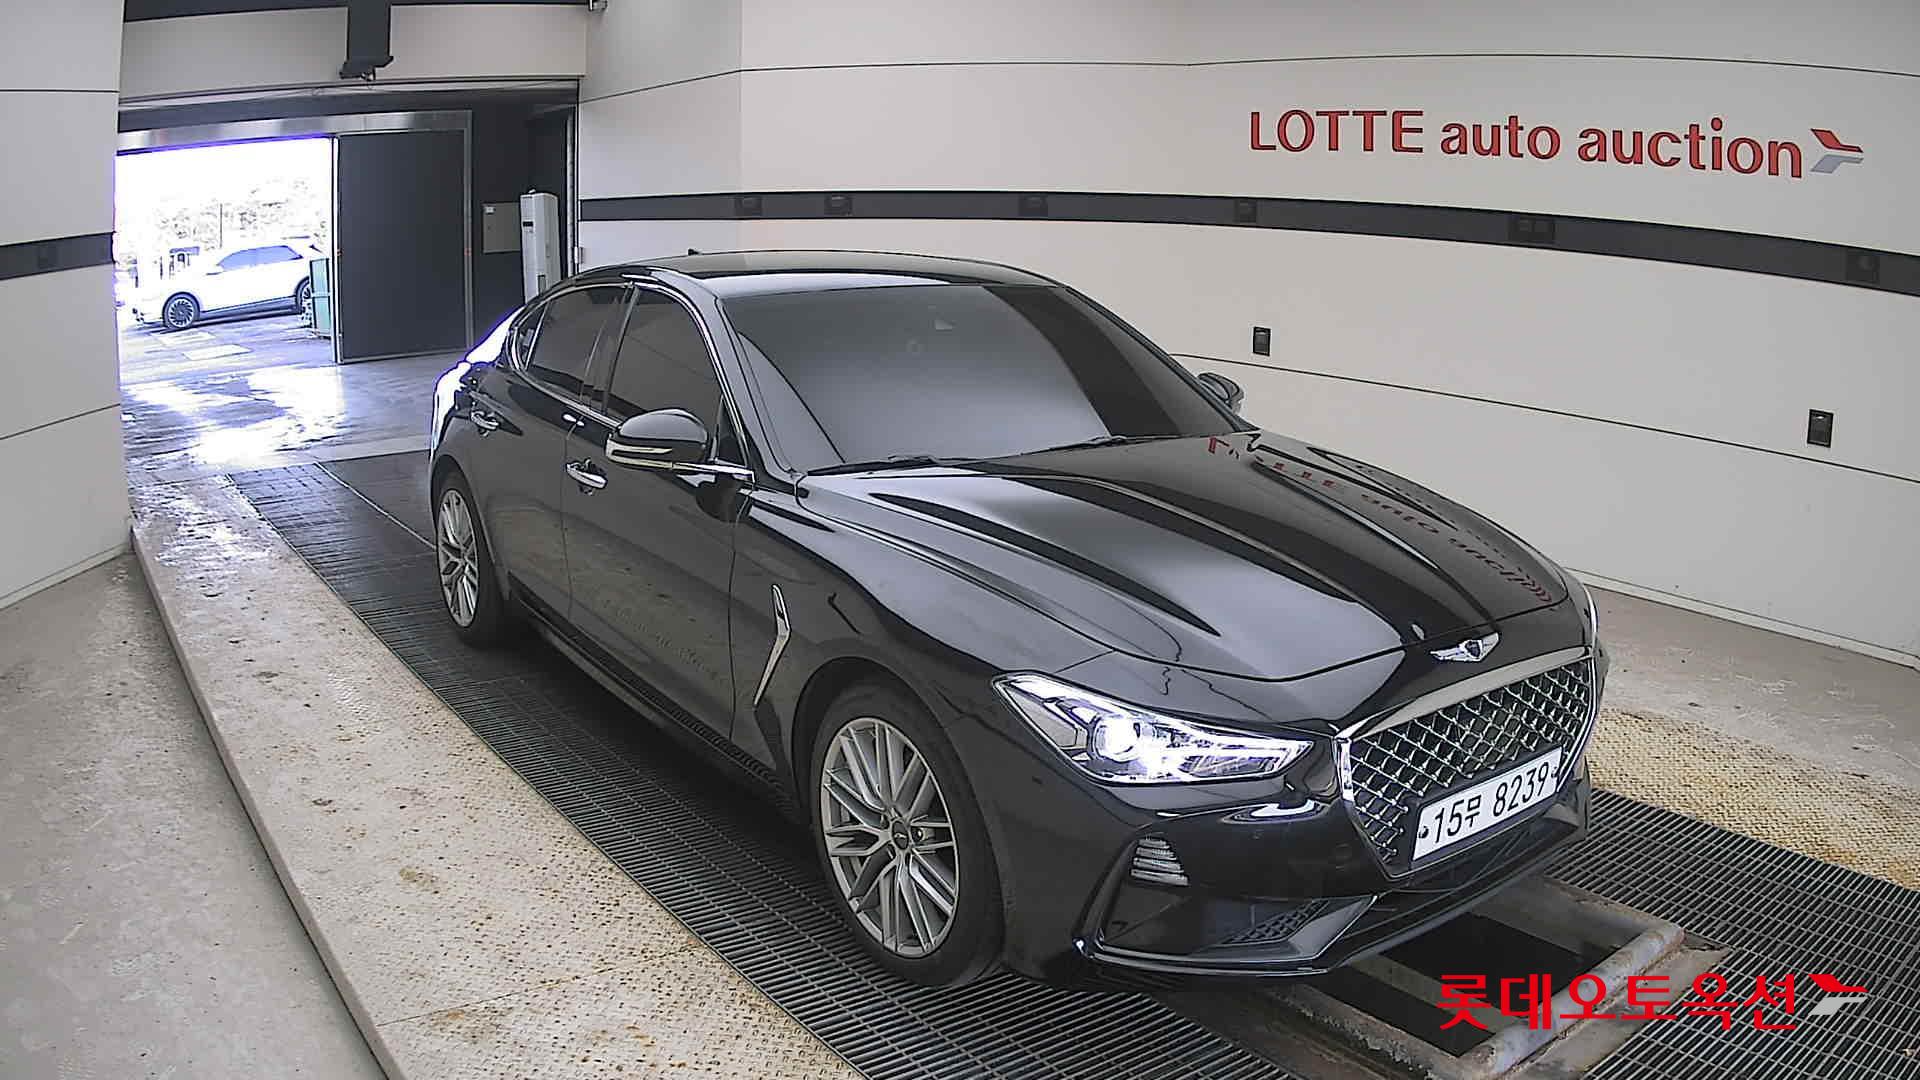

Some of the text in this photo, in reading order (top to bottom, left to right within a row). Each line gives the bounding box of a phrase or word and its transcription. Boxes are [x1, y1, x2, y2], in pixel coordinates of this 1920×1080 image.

[1250, 110, 1803, 179] LOTTE auto auction
[1435, 761, 1550, 844] 15무 8239
